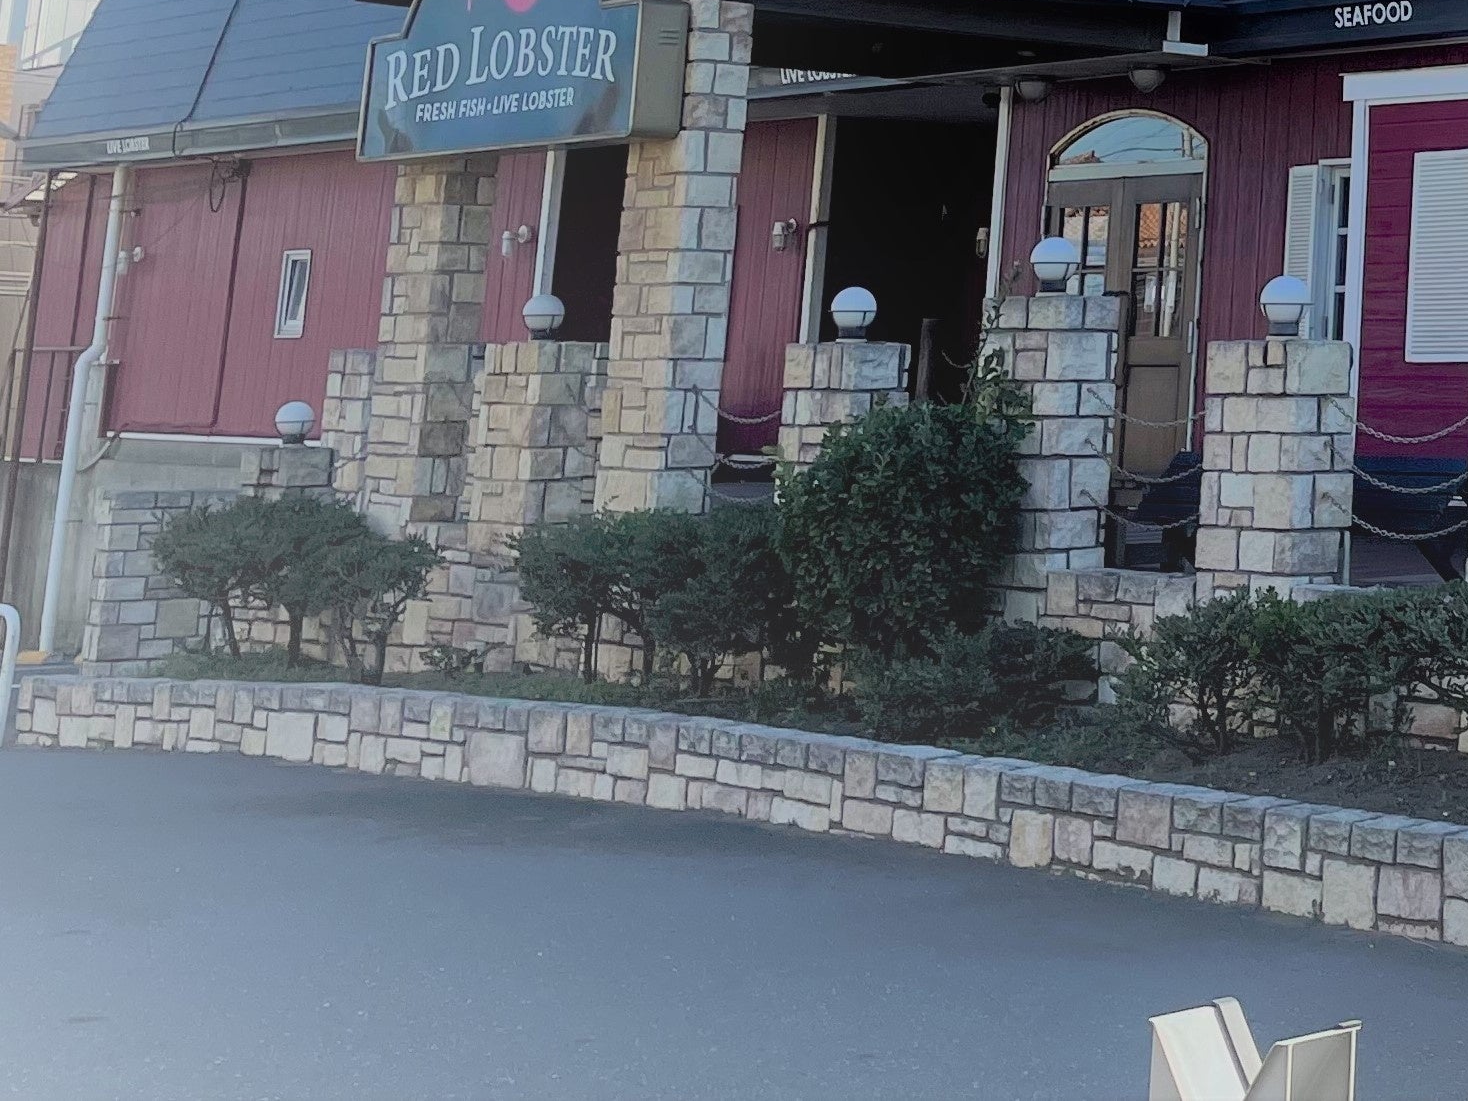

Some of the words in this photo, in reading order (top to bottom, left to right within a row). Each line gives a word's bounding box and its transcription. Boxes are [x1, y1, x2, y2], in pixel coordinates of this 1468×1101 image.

[1334, 0, 1413, 29] SEAFOOD
[384, 42, 460, 110] RED
[465, 25, 615, 86] LOBSTER
[415, 101, 456, 123] FRESH
[521, 87, 574, 111] LOBSTER
